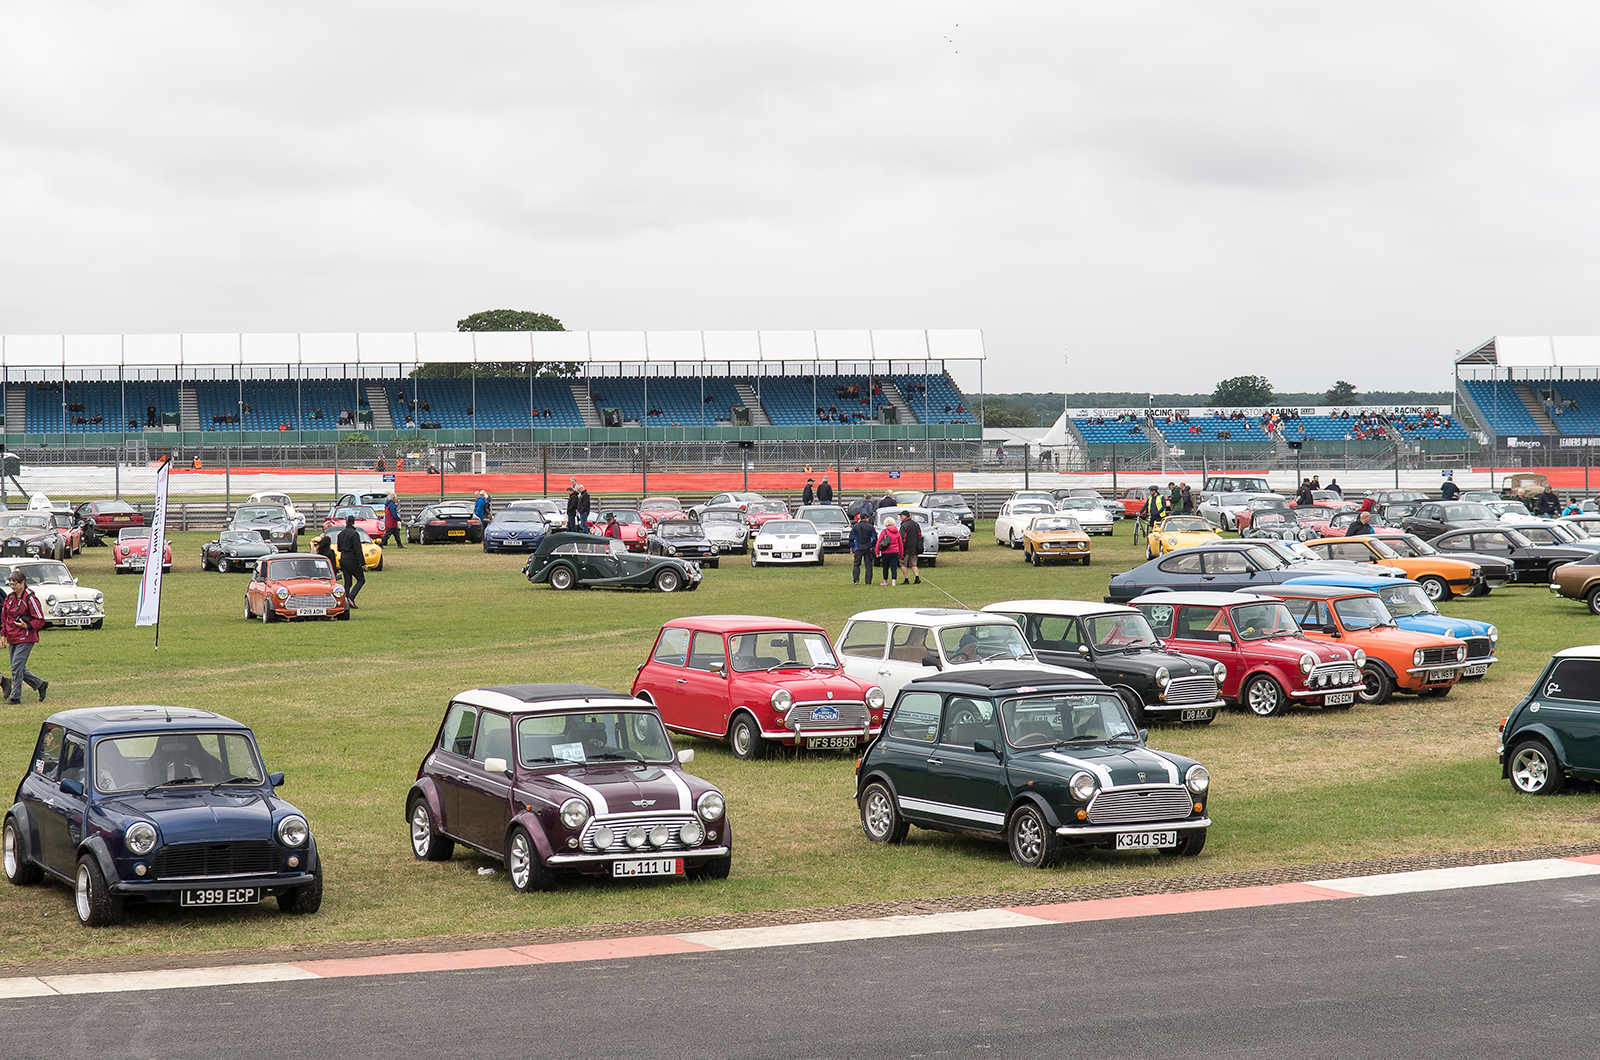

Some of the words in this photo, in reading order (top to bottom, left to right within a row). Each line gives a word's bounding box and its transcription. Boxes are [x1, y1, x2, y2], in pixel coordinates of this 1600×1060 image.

[1093, 408, 1143, 417] SILVERSTONE
[1144, 408, 1174, 417] RACING
[1394, 406, 1422, 415] RACING
[1559, 437, 1581, 447] LEADERS
[1326, 694, 1341, 704] Y425
[809, 738, 829, 748] WFS
[829, 737, 856, 747] 585K
[1117, 833, 1150, 847] K340
[1152, 832, 1176, 845] SBJ
[615, 863, 630, 875] EL
[638, 861, 659, 874] 111
[663, 860, 672, 873] U
[187, 890, 224, 904] L399
[228, 888, 255, 902] ECP
